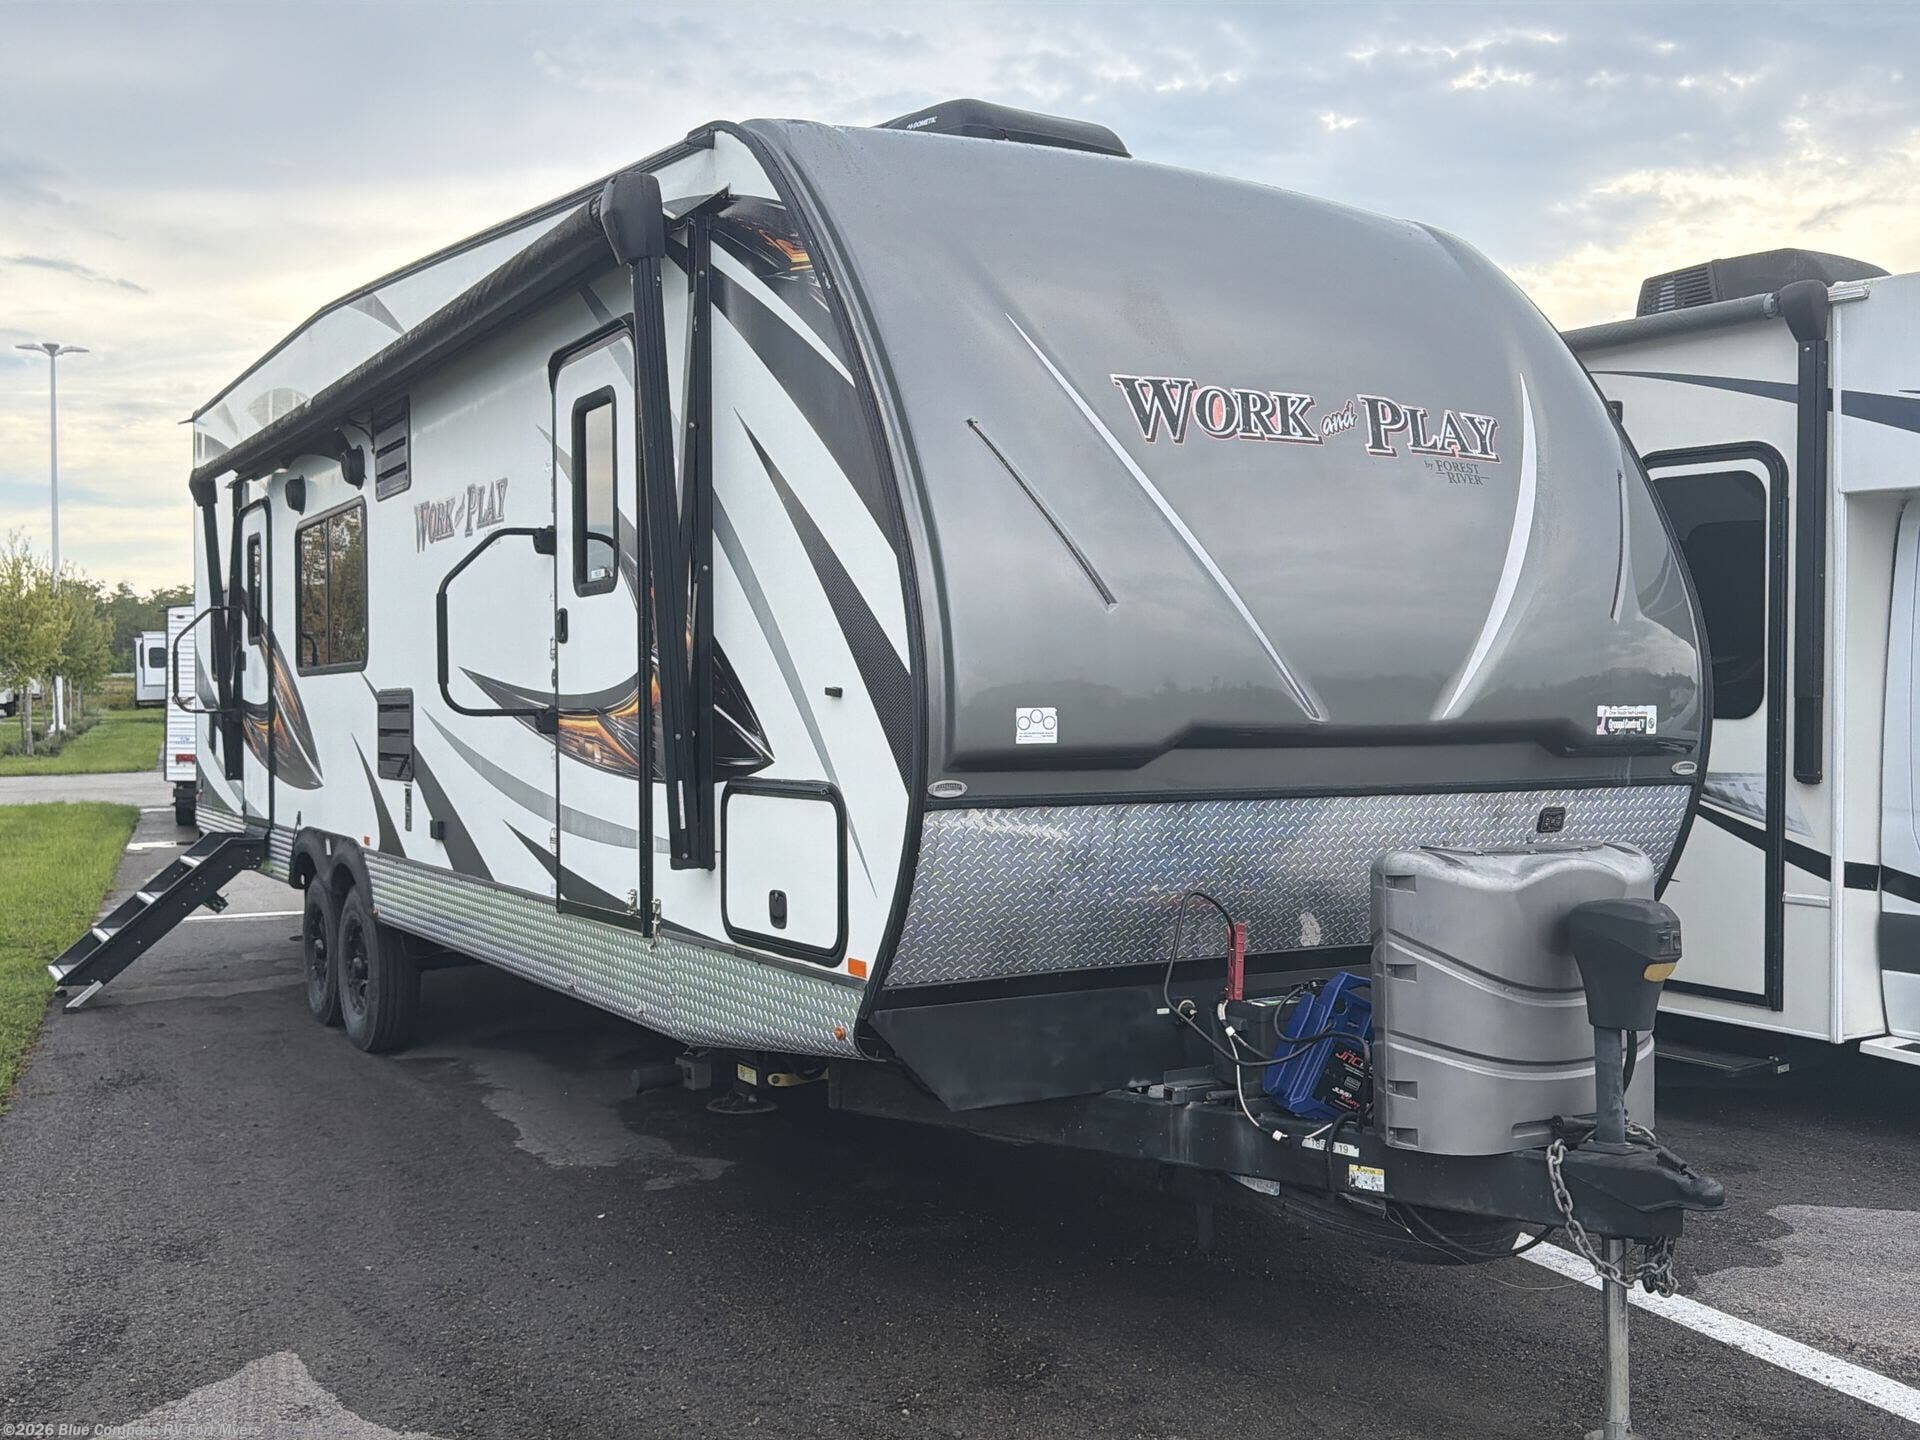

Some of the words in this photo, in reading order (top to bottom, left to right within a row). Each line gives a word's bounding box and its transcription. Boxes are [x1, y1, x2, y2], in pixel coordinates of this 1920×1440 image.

[1110, 373, 1323, 446] WORK
[1321, 400, 1358, 436] and
[1357, 394, 1501, 464] PLAY
[1424, 460, 1434, 471] by
[1434, 459, 1480, 475] FOREST
[1446, 472, 1484, 486] RIVER
[414, 496, 455, 553] WORK
[465, 477, 508, 538] PLAY
